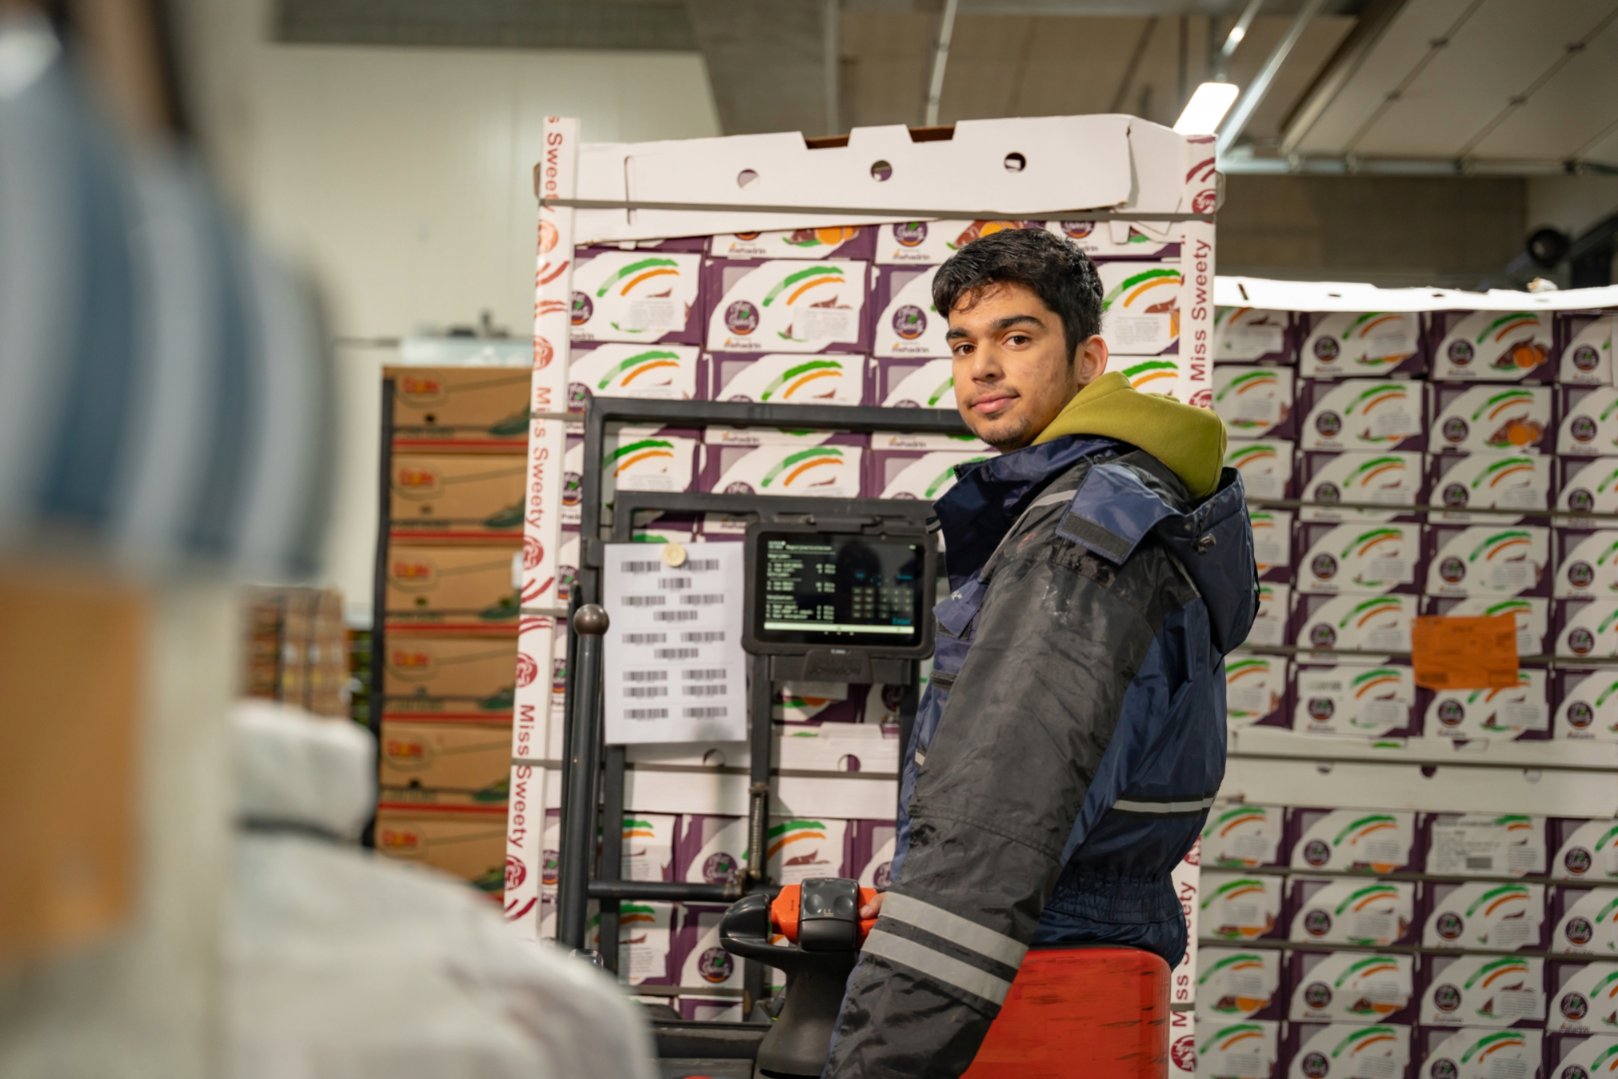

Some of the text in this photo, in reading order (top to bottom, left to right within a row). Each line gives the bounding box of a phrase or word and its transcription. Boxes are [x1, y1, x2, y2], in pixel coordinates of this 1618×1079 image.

[1190, 239, 1212, 382] Miss Sweety
[525, 386, 552, 529] Mis Sweety
[508, 704, 536, 849] Miss Sweety
[1172, 974, 1189, 1028] Mss
